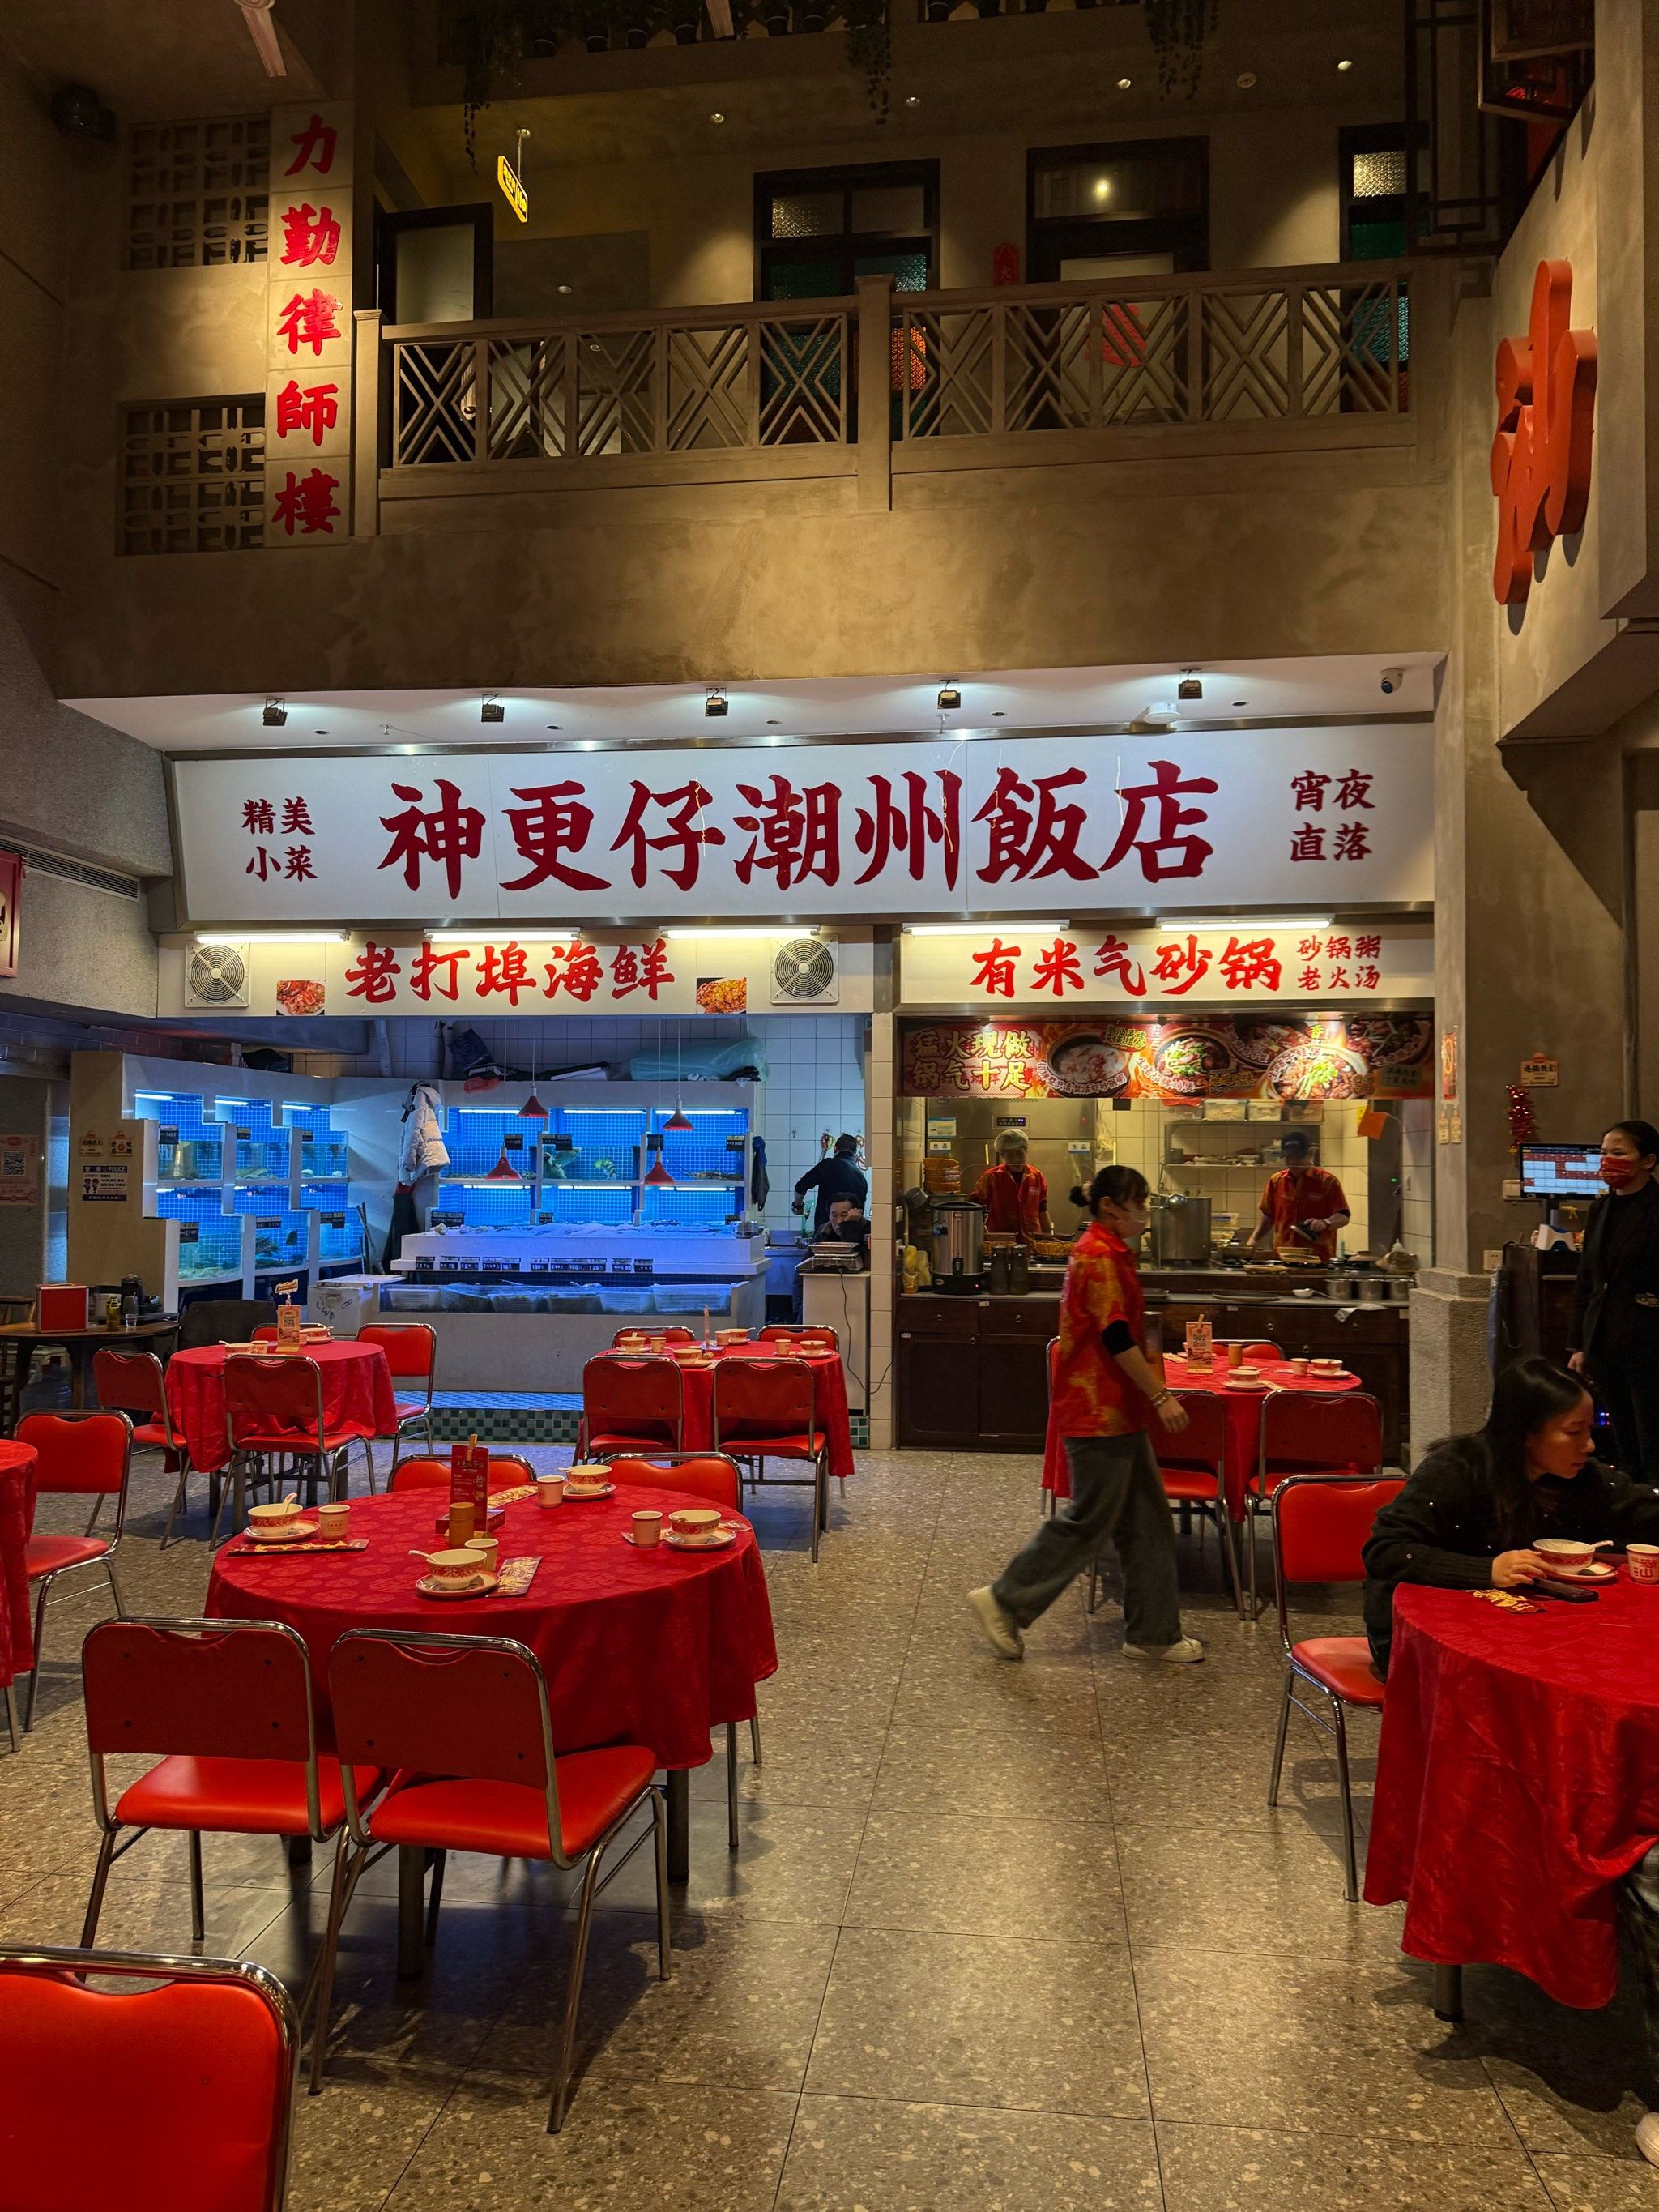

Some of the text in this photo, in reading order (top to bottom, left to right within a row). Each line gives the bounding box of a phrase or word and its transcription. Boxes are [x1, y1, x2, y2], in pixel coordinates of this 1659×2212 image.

[272, 114, 343, 536] 力勤律師樓
[1290, 768, 1376, 812] 宵夜
[241, 796, 316, 835] 精美
[377, 759, 1218, 900] 神更仔潮州飯店
[1290, 822, 1374, 863] 直落
[245, 844, 318, 882] 小菜
[970, 933, 1282, 998] 有米气砂锅
[1296, 935, 1382, 962] 砂锅粥
[345, 938, 675, 1007] 老打埠海鲜
[1298, 965, 1380, 991] 老火汤
[911, 1030, 1035, 1059] 猛火现做
[913, 1060, 1033, 1090] 锅气十足
